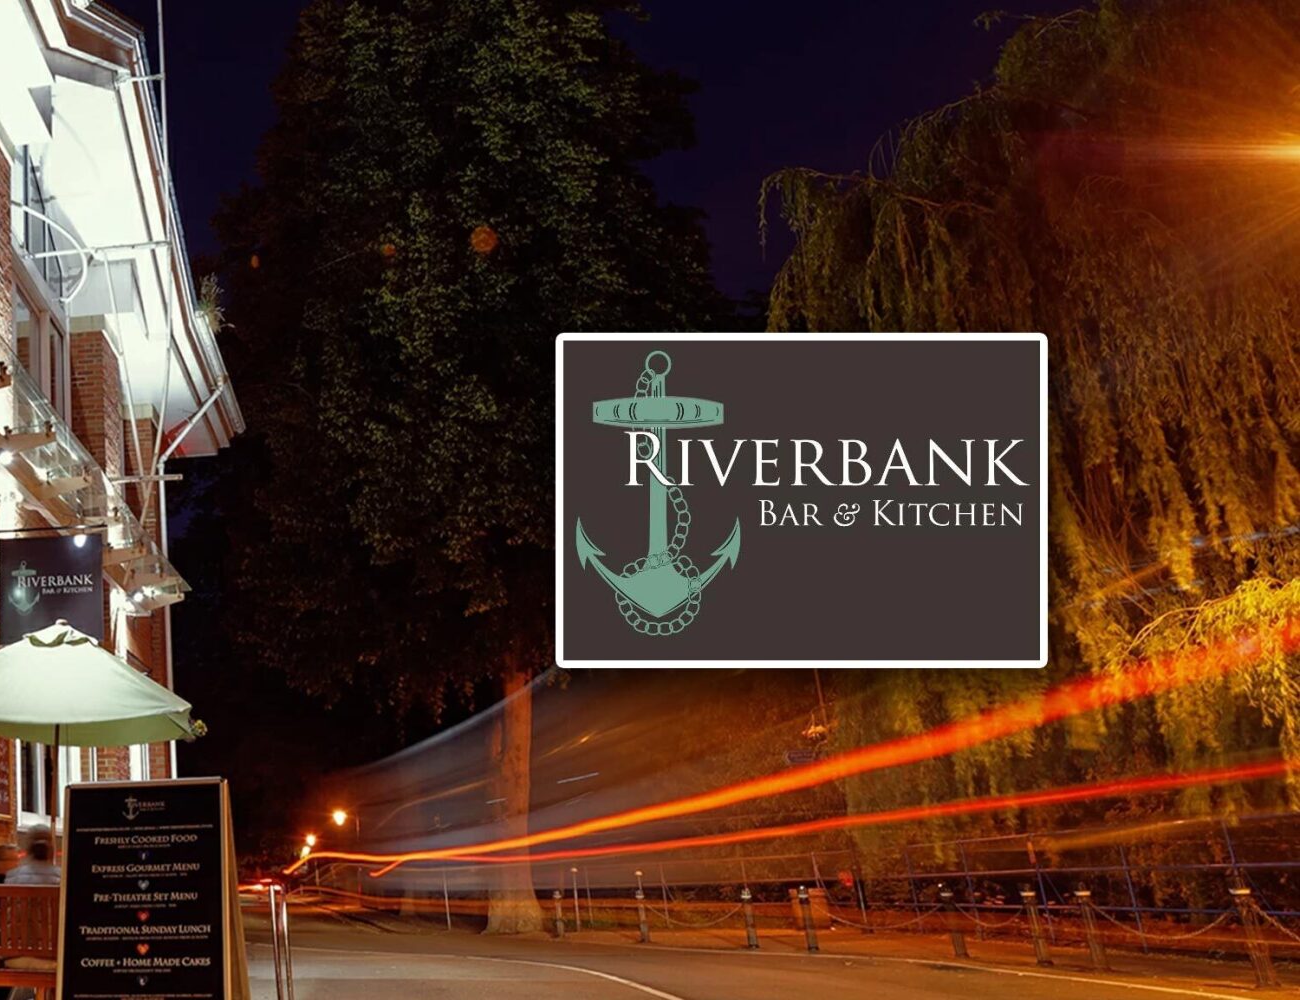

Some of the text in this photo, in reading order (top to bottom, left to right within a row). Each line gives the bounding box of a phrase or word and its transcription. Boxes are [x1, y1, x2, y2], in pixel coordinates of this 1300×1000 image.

[17, 574, 93, 587] RIVERBANK
[94, 834, 198, 845] FRESHLY COOKED FOOD
[91, 863, 200, 873] EXPRESS GOURMET MENU
[171, 892, 198, 900] MENU
[79, 924, 211, 935] TRADITIONAL SUNDAY LUNCH
[80, 957, 211, 967] COFFEE HOME MADE CAKES
